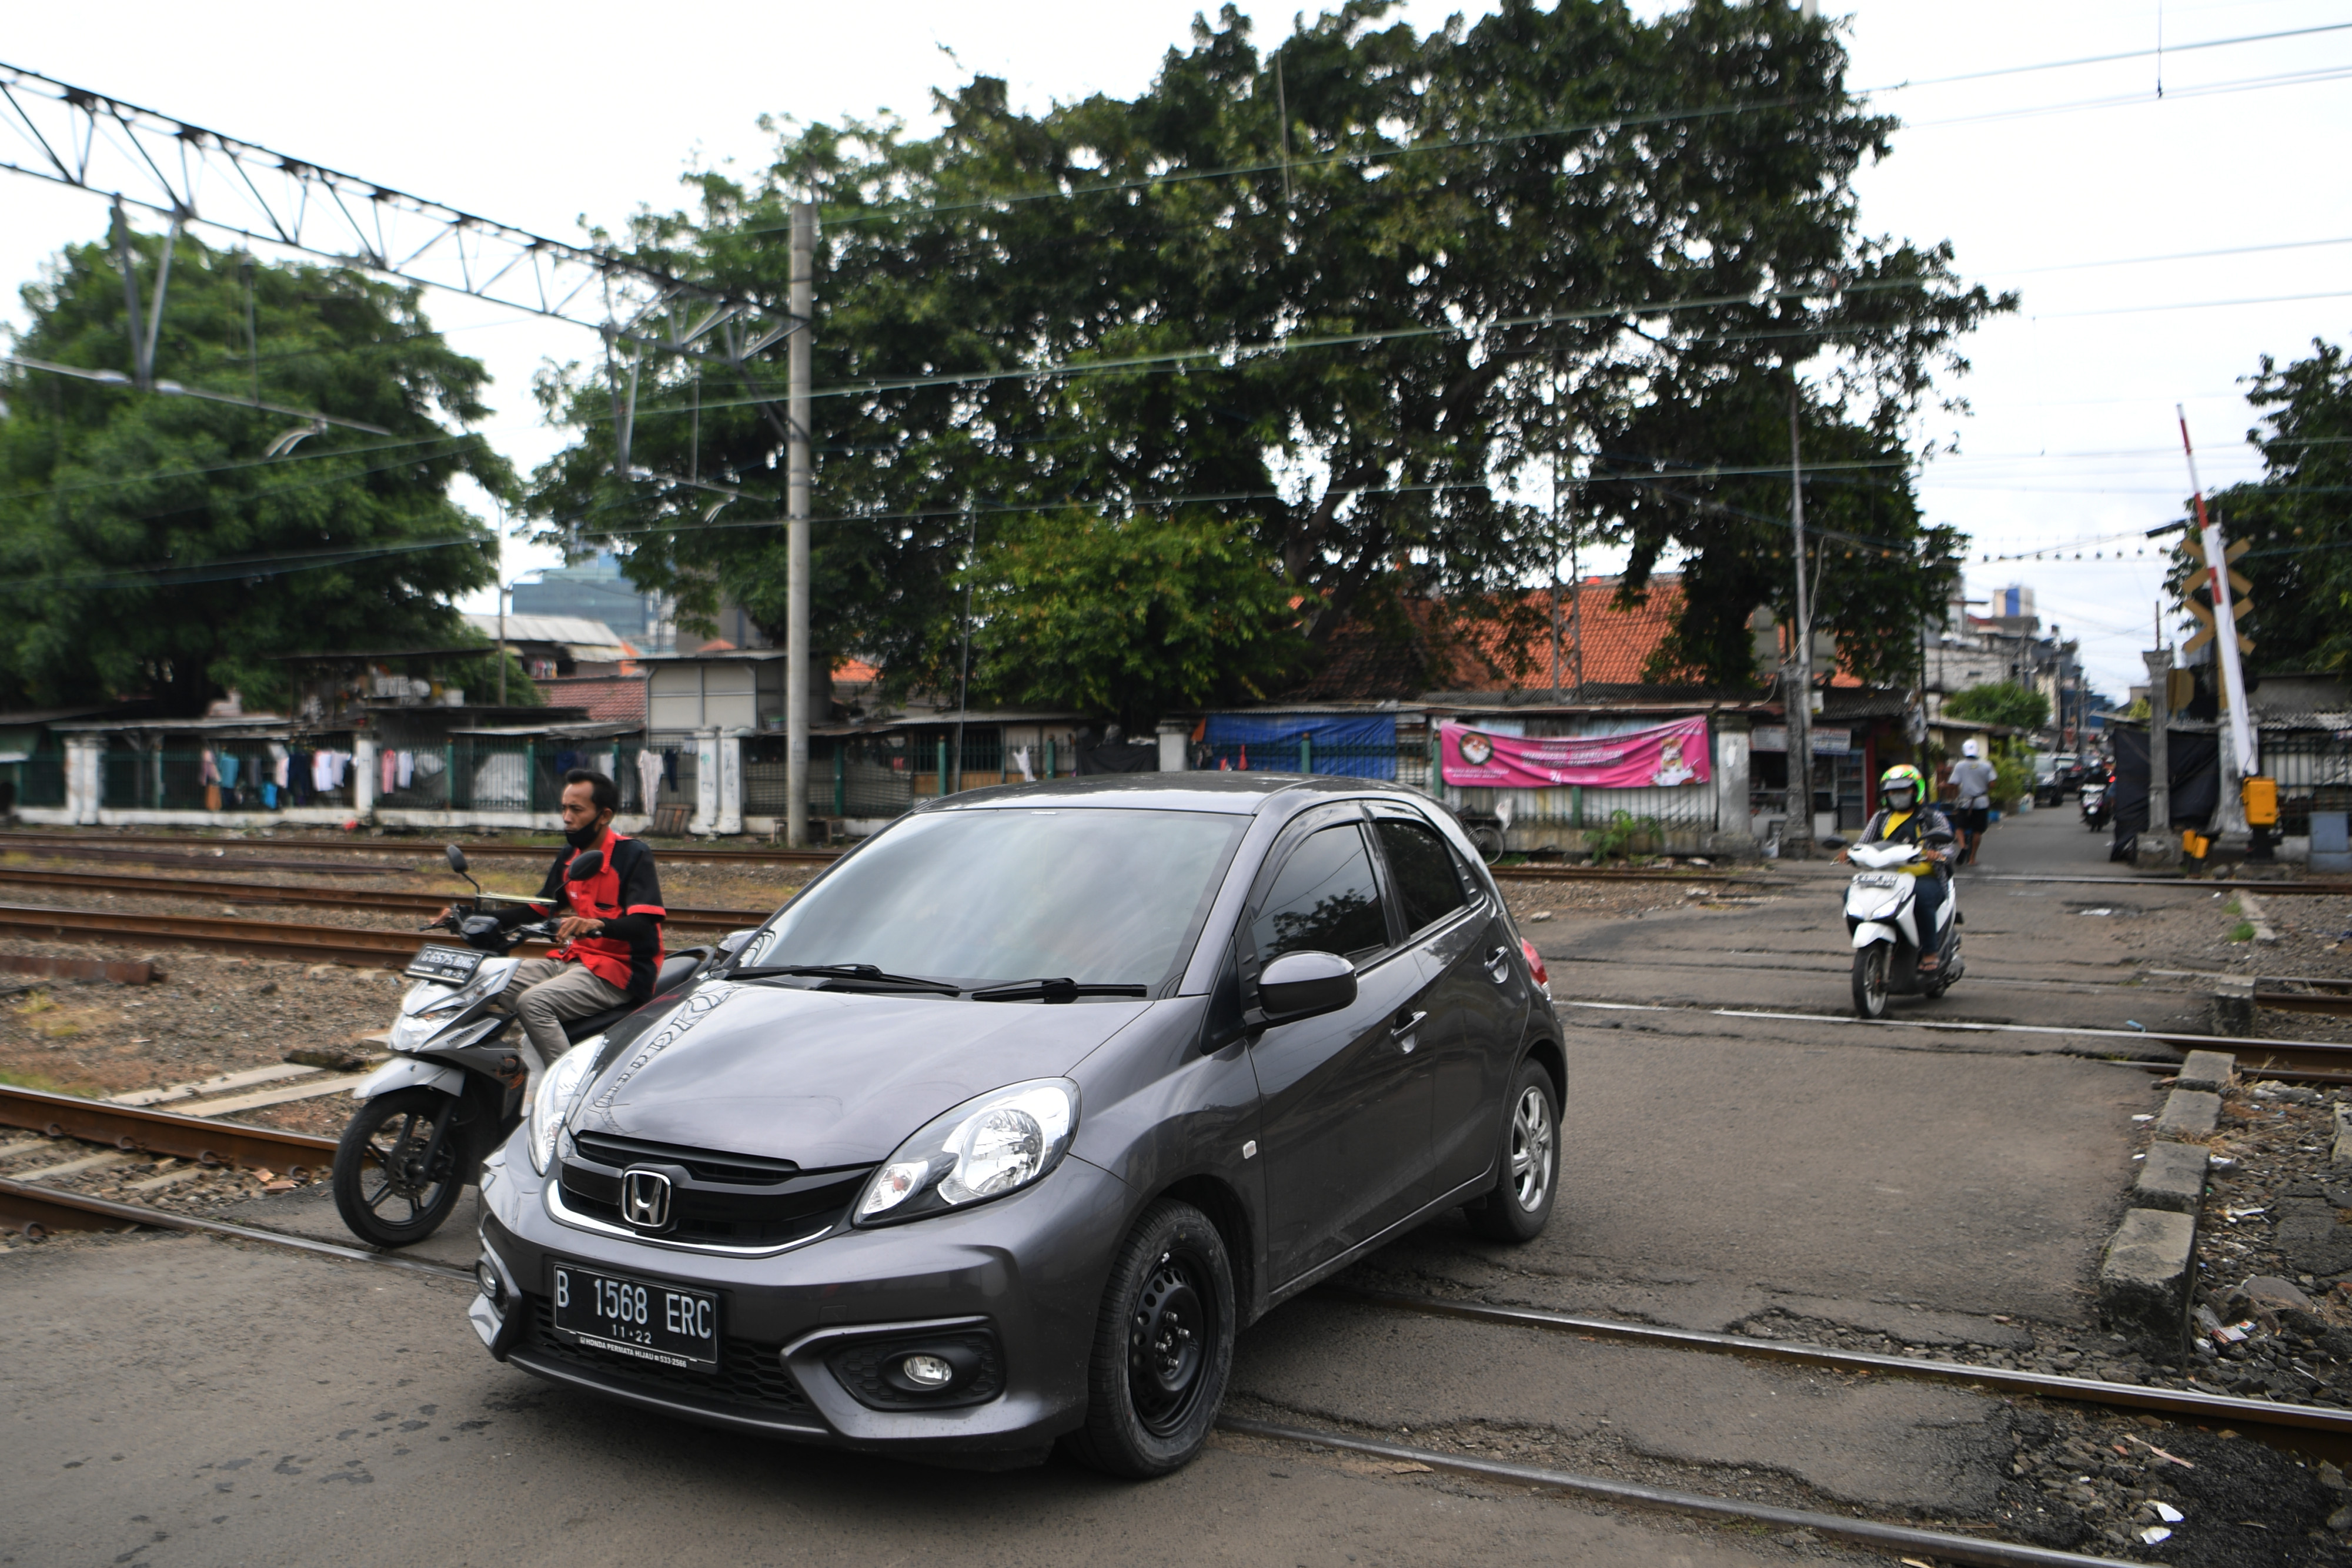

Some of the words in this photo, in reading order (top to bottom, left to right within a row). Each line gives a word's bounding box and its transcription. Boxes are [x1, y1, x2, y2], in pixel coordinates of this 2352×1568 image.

[446, 1029, 476, 1045] HONDA
[556, 1270, 570, 1308] B
[594, 1278, 648, 1325] 1568
[666, 1293, 712, 1339] ERC
[586, 1338, 606, 1349] HONDA
[606, 1343, 634, 1356] PERMATA
[634, 1350, 654, 1360] HIJAU
